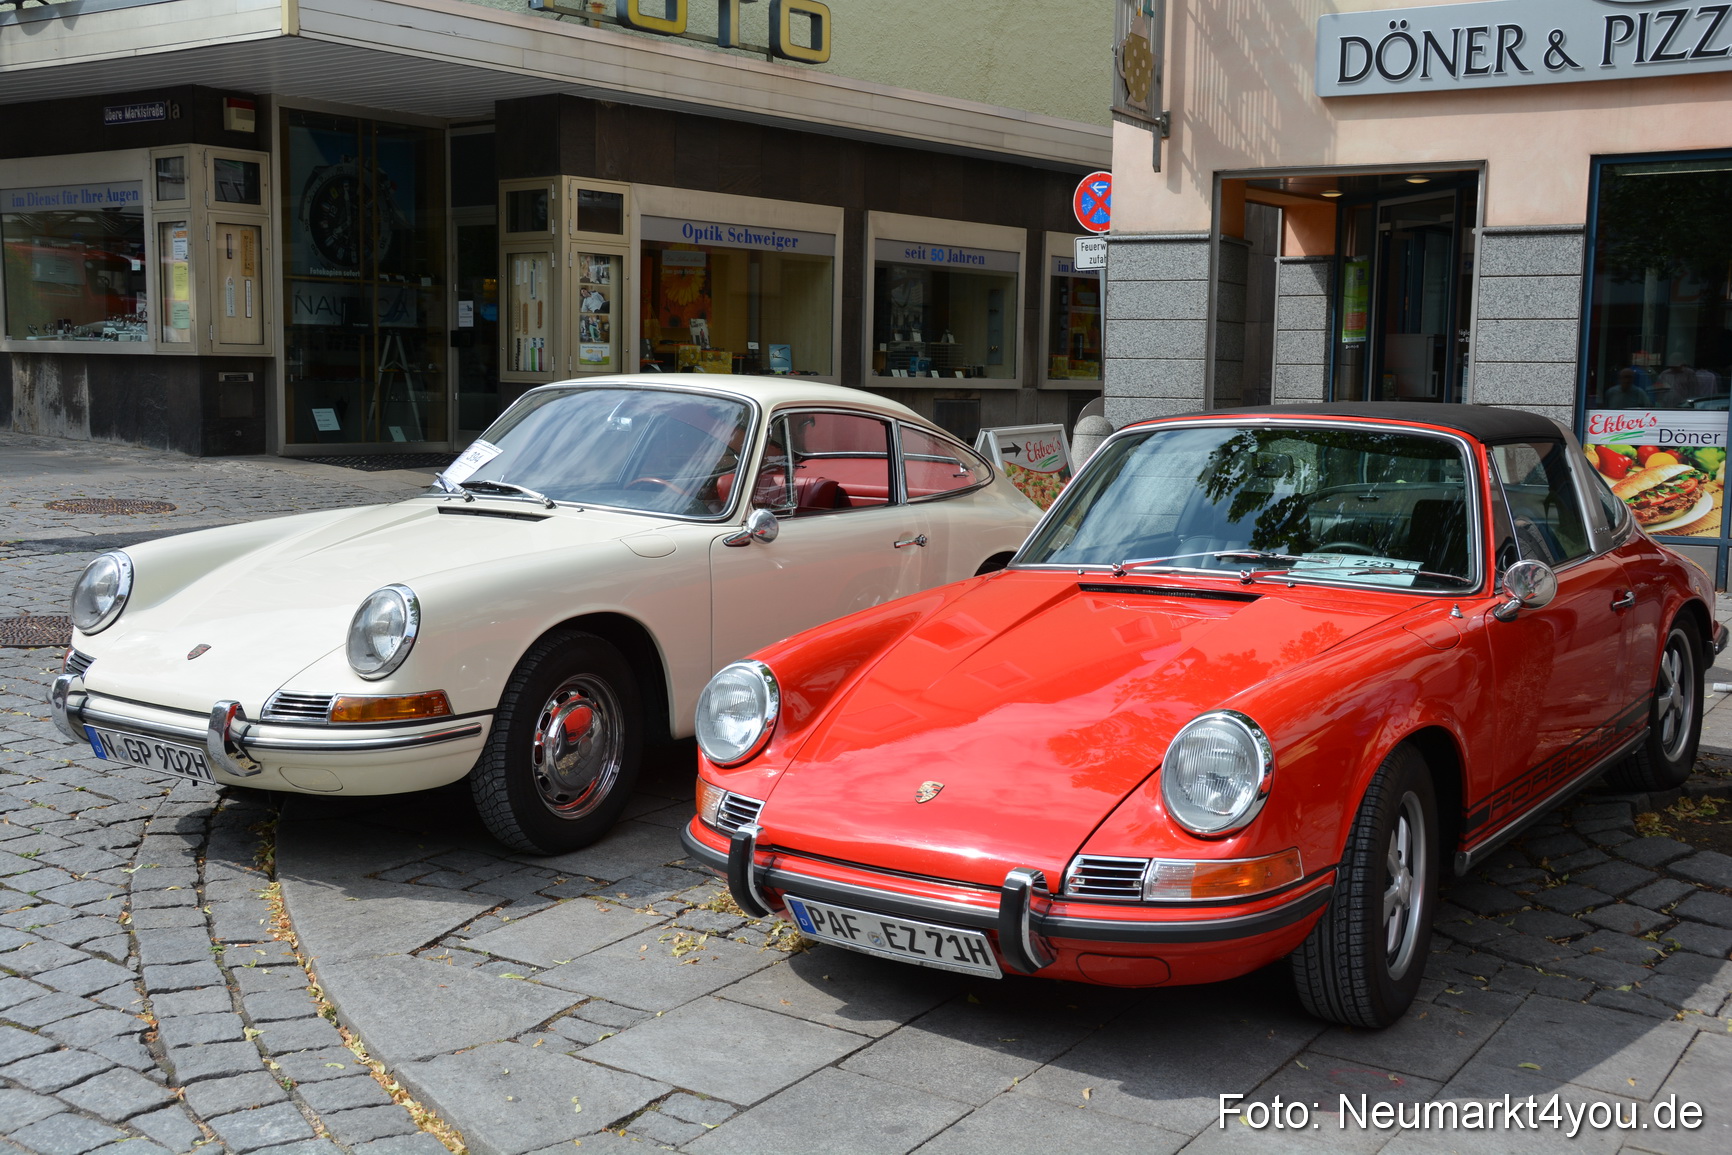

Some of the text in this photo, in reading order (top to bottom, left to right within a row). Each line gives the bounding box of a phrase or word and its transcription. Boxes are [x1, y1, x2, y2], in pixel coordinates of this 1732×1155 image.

[1337, 4, 1732, 83] DÖNER & PIZZ
[125, 103, 163, 119] Marktstraße
[12, 187, 139, 207] im Dienst für Ihre Augen
[682, 222, 799, 251] Optik Schweiger
[905, 246, 985, 265] seit 50 Jahren
[1081, 242, 1106, 252] Feuerw
[1058, 260, 1069, 273] im
[294, 294, 410, 319] NAUCA
[1658, 428, 1721, 444] Döner
[97, 732, 212, 780] N GP 902H
[1489, 724, 1617, 821] PORSCHE
[799, 917, 809, 927] D
[805, 905, 862, 940] PAF
